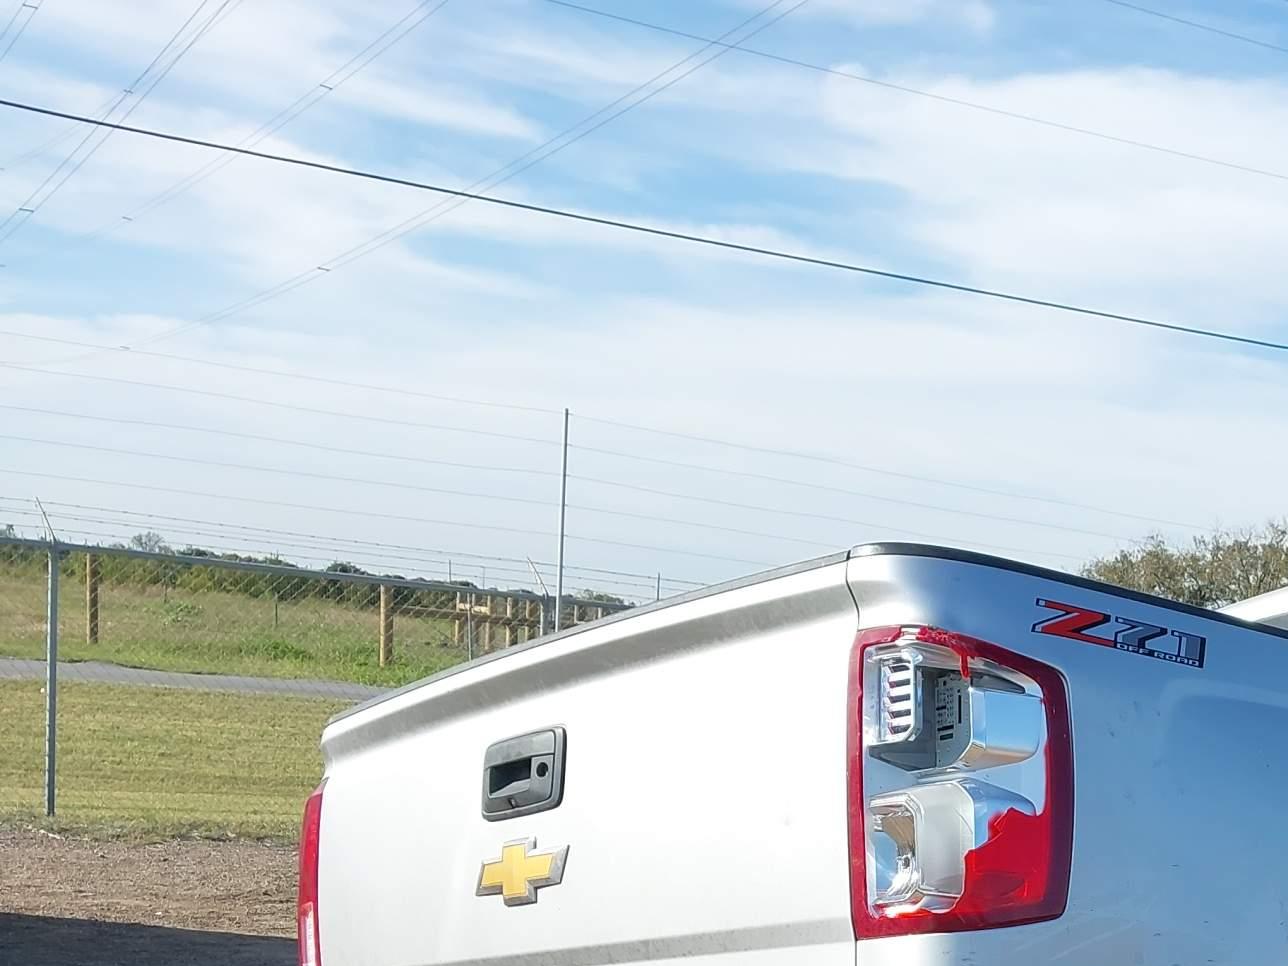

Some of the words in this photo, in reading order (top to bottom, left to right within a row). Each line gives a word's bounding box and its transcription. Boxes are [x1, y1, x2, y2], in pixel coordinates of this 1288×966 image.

[1031, 598, 1207, 662] Z71
[1116, 643, 1150, 655] OFF
[1153, 651, 1200, 667] ROAD
